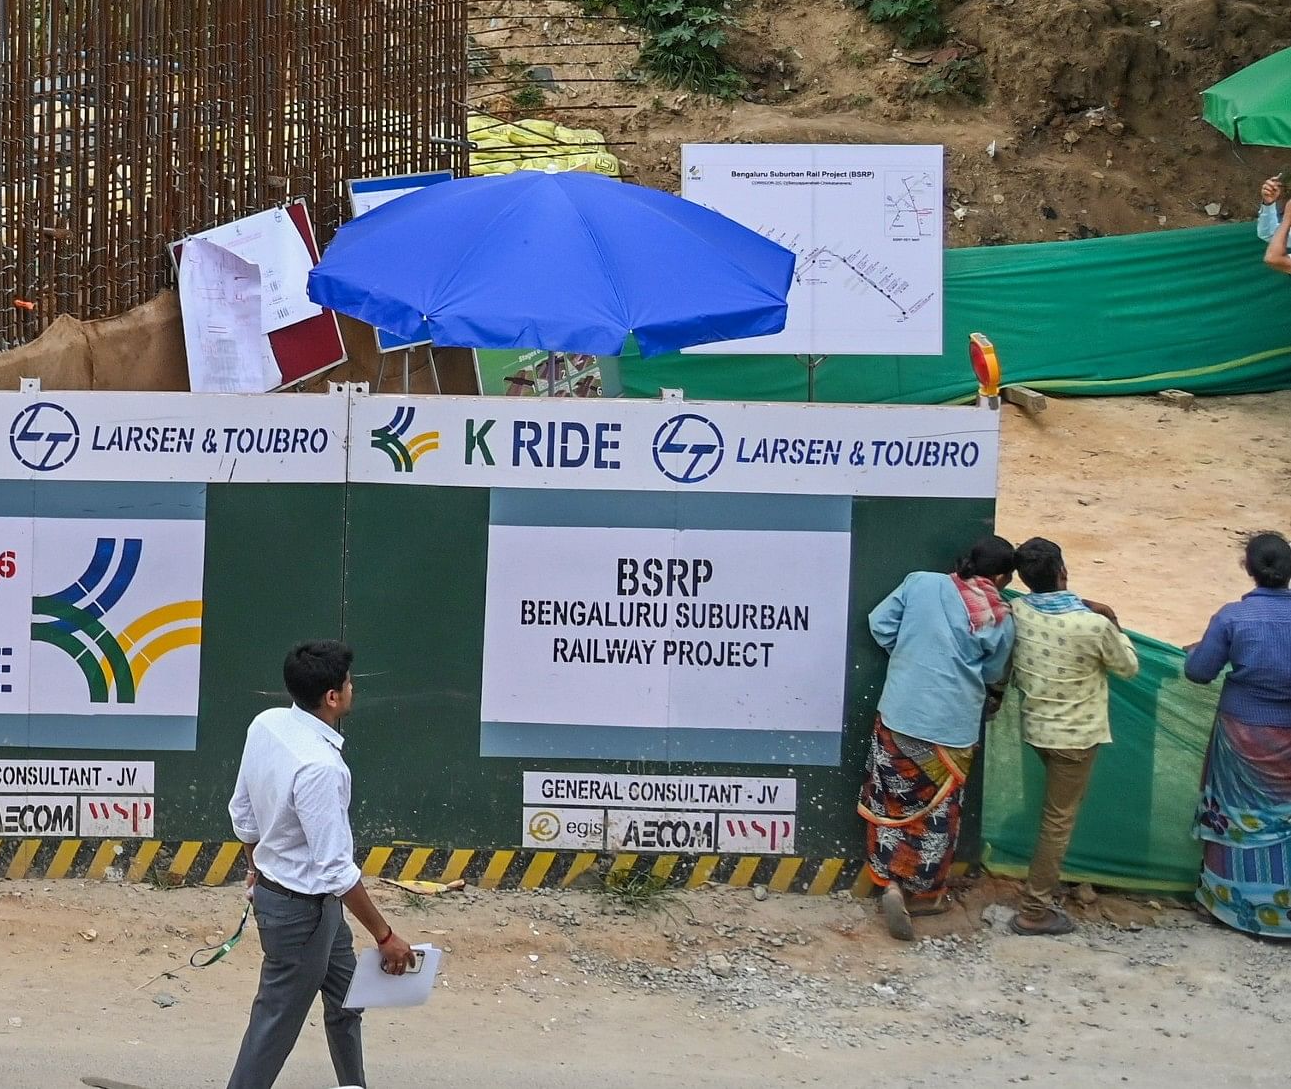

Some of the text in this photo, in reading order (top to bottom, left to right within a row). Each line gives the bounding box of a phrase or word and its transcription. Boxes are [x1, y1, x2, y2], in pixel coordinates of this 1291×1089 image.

[731, 171, 768, 179] Bengaluru
[822, 171, 847, 179] Project
[849, 171, 875, 179] (BSRP)
[92, 426, 328, 453] LARSEN & TOUBRO
[465, 419, 621, 469] K RIDE
[737, 438, 978, 467] LARSEN & TOUBRO
[617, 558, 712, 597] BSRP
[521, 600, 808, 630] BENGALURU SUBURBAN
[554, 638, 774, 667] RAILWAY PROJECT
[117, 768, 137, 787] JV
[542, 780, 623, 800] GENERAL
[629, 782, 742, 803] CONSULTANT
[757, 785, 778, 804] JV
[566, 820, 602, 838] egis
[622, 820, 712, 848] AECOM
